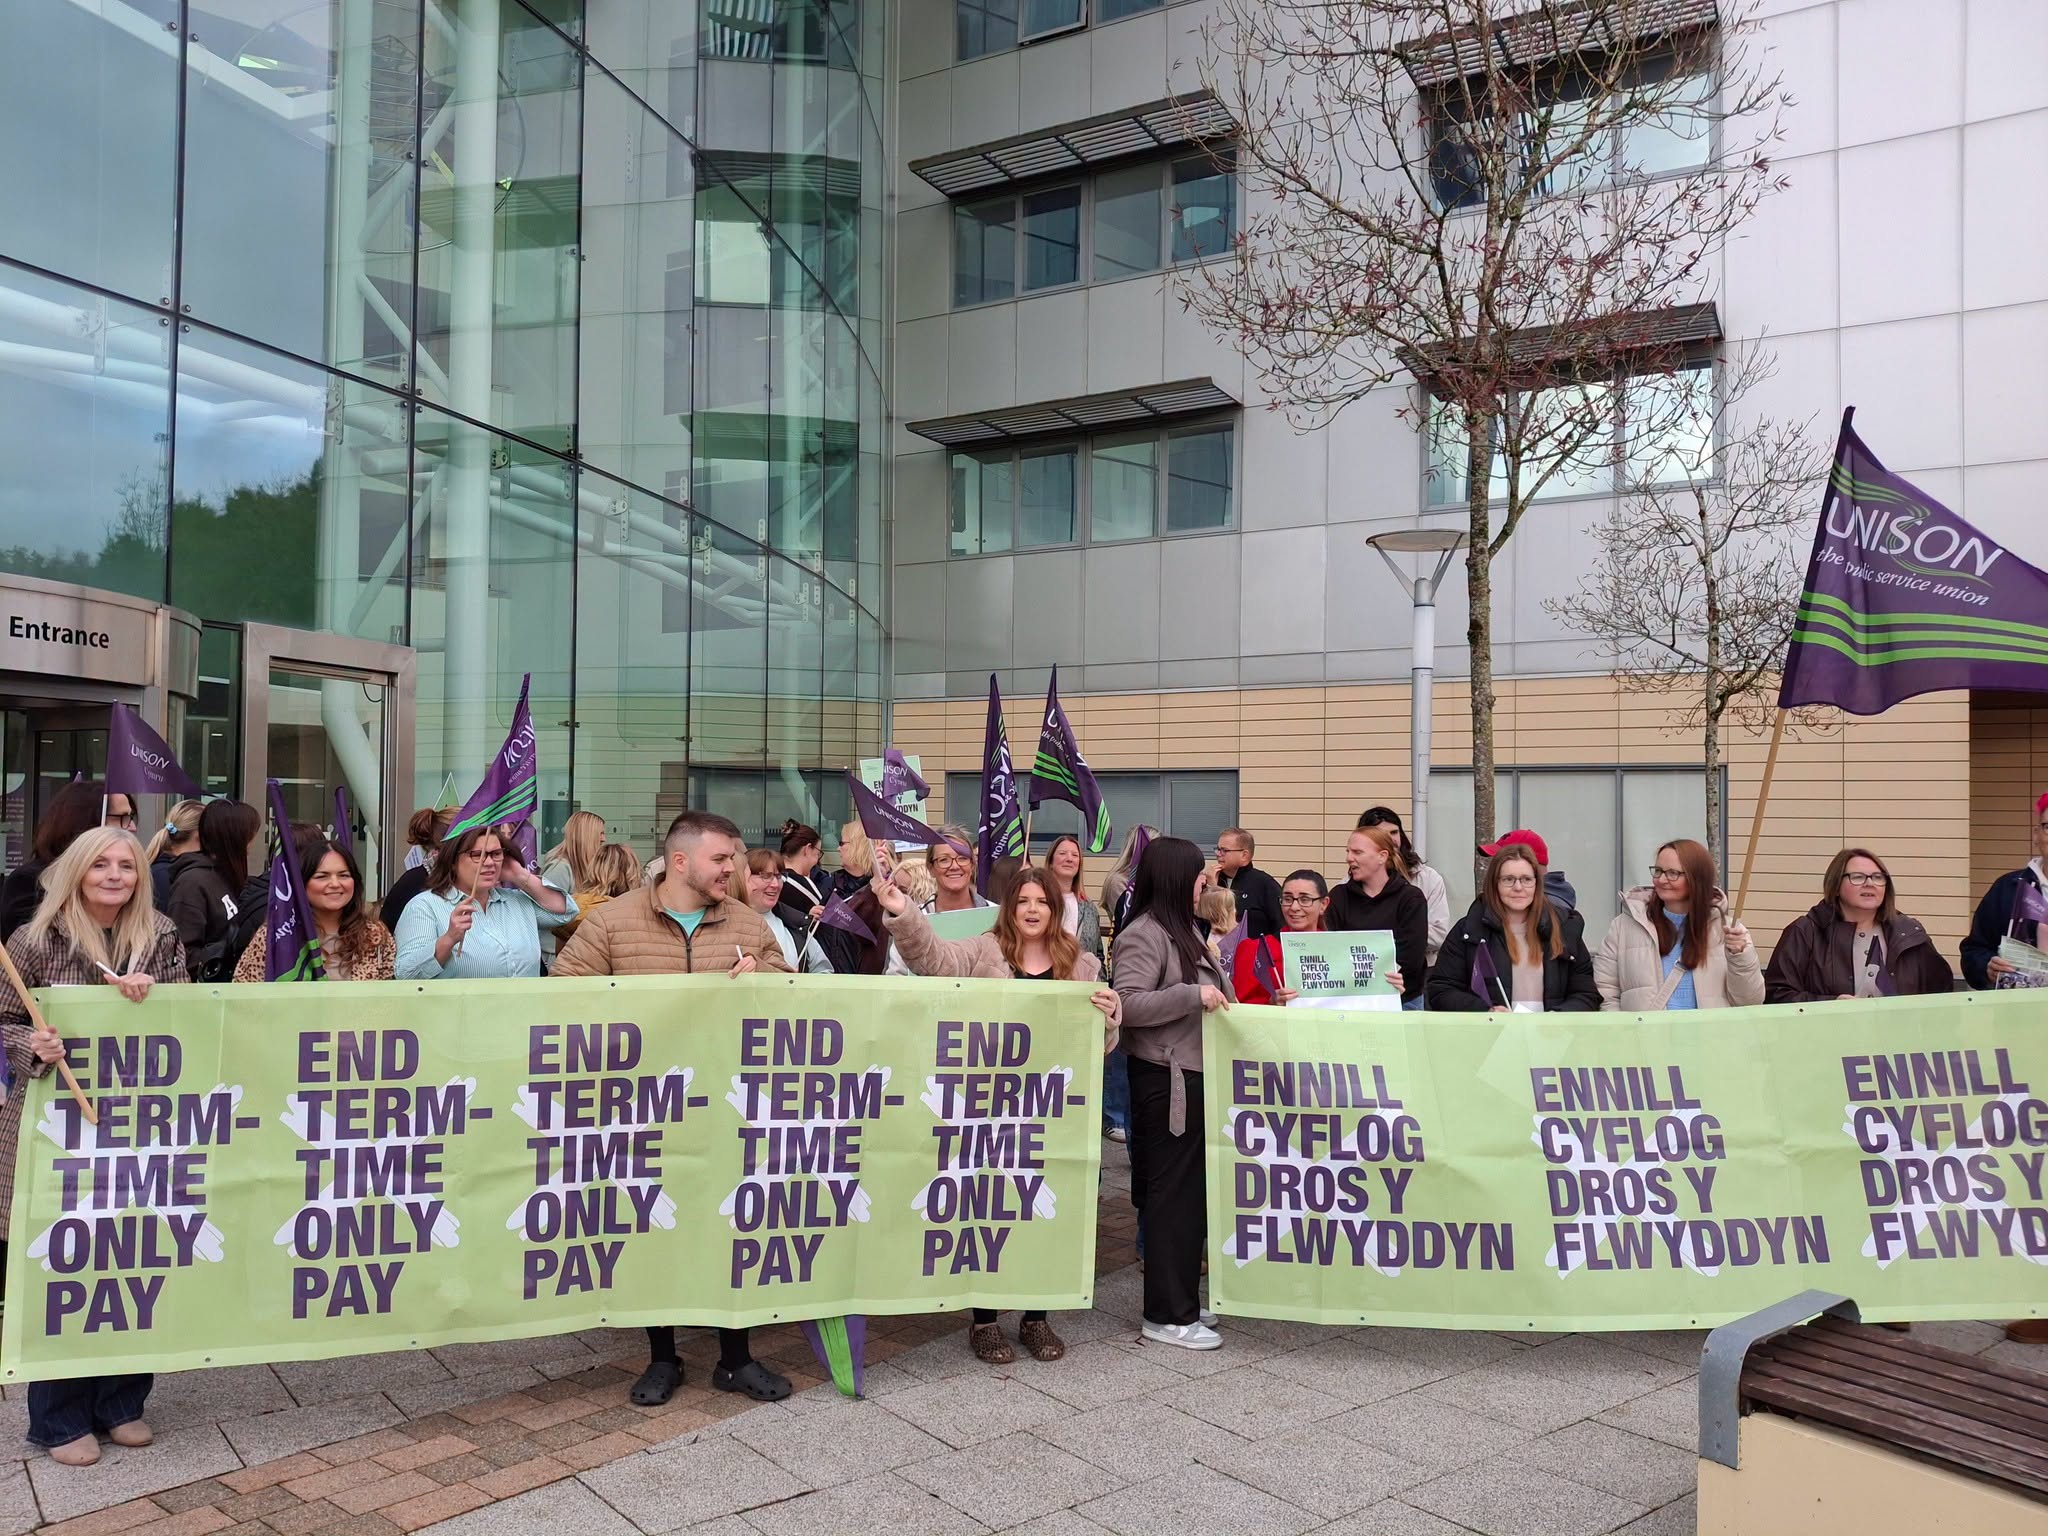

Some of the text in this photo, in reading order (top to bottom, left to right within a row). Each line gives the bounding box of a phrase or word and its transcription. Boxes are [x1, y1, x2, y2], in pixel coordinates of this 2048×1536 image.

[1826, 497, 2004, 576] UNISON
[1816, 547, 1844, 565] the
[1876, 570, 1931, 591] service
[1933, 582, 1990, 606] union
[10, 615, 109, 648] Entrance
[884, 765, 908, 776] ISON
[874, 804, 914, 830] UNISON
[221, 894, 239, 920] A
[1300, 955, 1326, 963] ENNILL
[1302, 980, 1345, 989] FLWYDDYN
[1353, 962, 1373, 970] TIME
[55, 1035, 182, 1090] END
[298, 1029, 419, 1084] END
[529, 1022, 642, 1075] END
[741, 1019, 843, 1066] END
[936, 1021, 1031, 1068] END
[528, 1074, 708, 1129] TERM-
[740, 1072, 904, 1120] TERM-
[935, 1073, 1085, 1119] TERM-
[1232, 1060, 1403, 1109] ENNILL
[1529, 1066, 1701, 1112] ENNILL
[1841, 1048, 2029, 1102] ENNILL
[53, 1093, 260, 1150] TERM-
[297, 1085, 492, 1142] TERM-
[1234, 1111, 1424, 1162] CYFLOG
[1540, 1115, 1726, 1164] CYFLOG
[1853, 1099, 2048, 1153] CYFLOG
[296, 1143, 444, 1200] TIME
[527, 1130, 663, 1186] TIME
[738, 1126, 862, 1176] TIME
[931, 1123, 1045, 1170] TIME
[52, 1153, 207, 1212] TIME
[735, 1179, 860, 1232] ONLY
[927, 1175, 1043, 1224] ONLY
[1235, 1163, 1413, 1214] DROS Y
[1546, 1167, 1716, 1216] DROS Y
[1860, 1152, 2045, 1207] DROS Y
[294, 1200, 445, 1260] ONLY
[525, 1184, 663, 1243] ONLY
[1869, 1207, 2048, 1261] FLWYD
[48, 1213, 208, 1274] ONLY
[730, 1234, 825, 1289] PAY
[922, 1227, 1010, 1276] PAY
[1235, 1215, 1514, 1271] FLWYDDYN
[1553, 1215, 1830, 1271] FLWYDDYN
[292, 1262, 404, 1319] PAY
[523, 1241, 625, 1300] PAY
[45, 1276, 165, 1336] PAY
